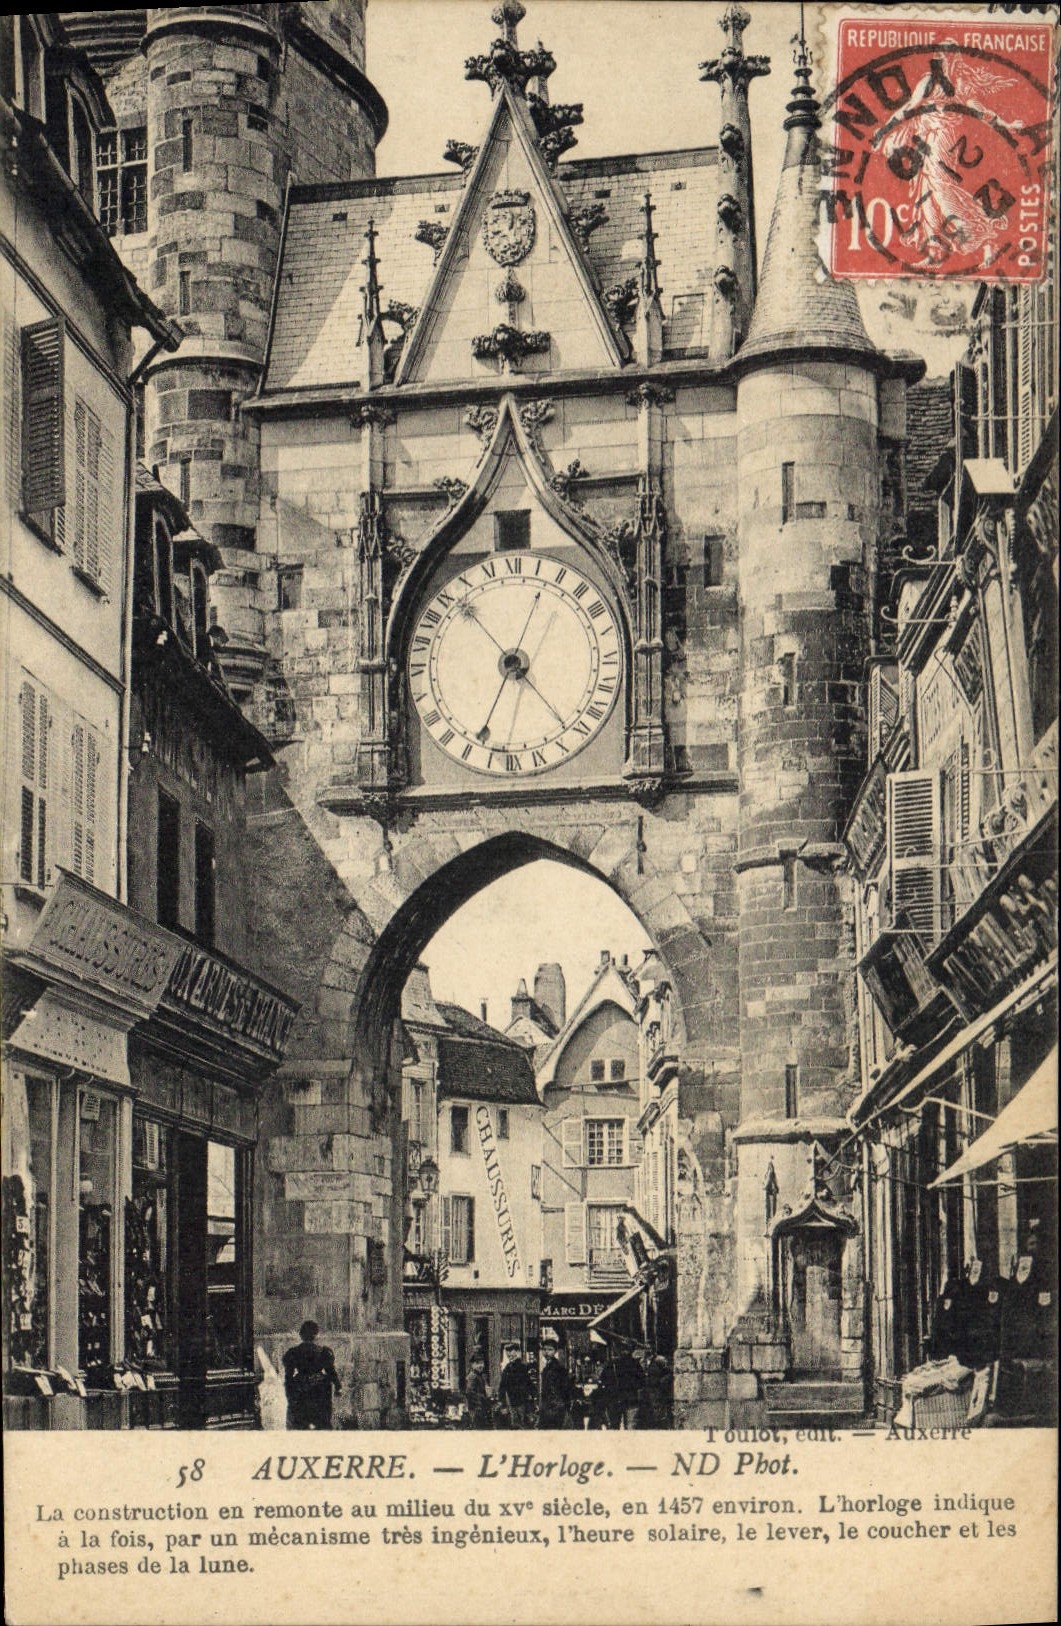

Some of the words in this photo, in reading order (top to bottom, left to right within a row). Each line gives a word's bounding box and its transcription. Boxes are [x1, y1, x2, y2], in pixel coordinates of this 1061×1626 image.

[963, 32, 1047, 52] FRANÇAISE
[847, 197, 893, 251] 10
[1017, 182, 1042, 268] POSTES
[477, 1105, 520, 1278] CHAUSSURES
